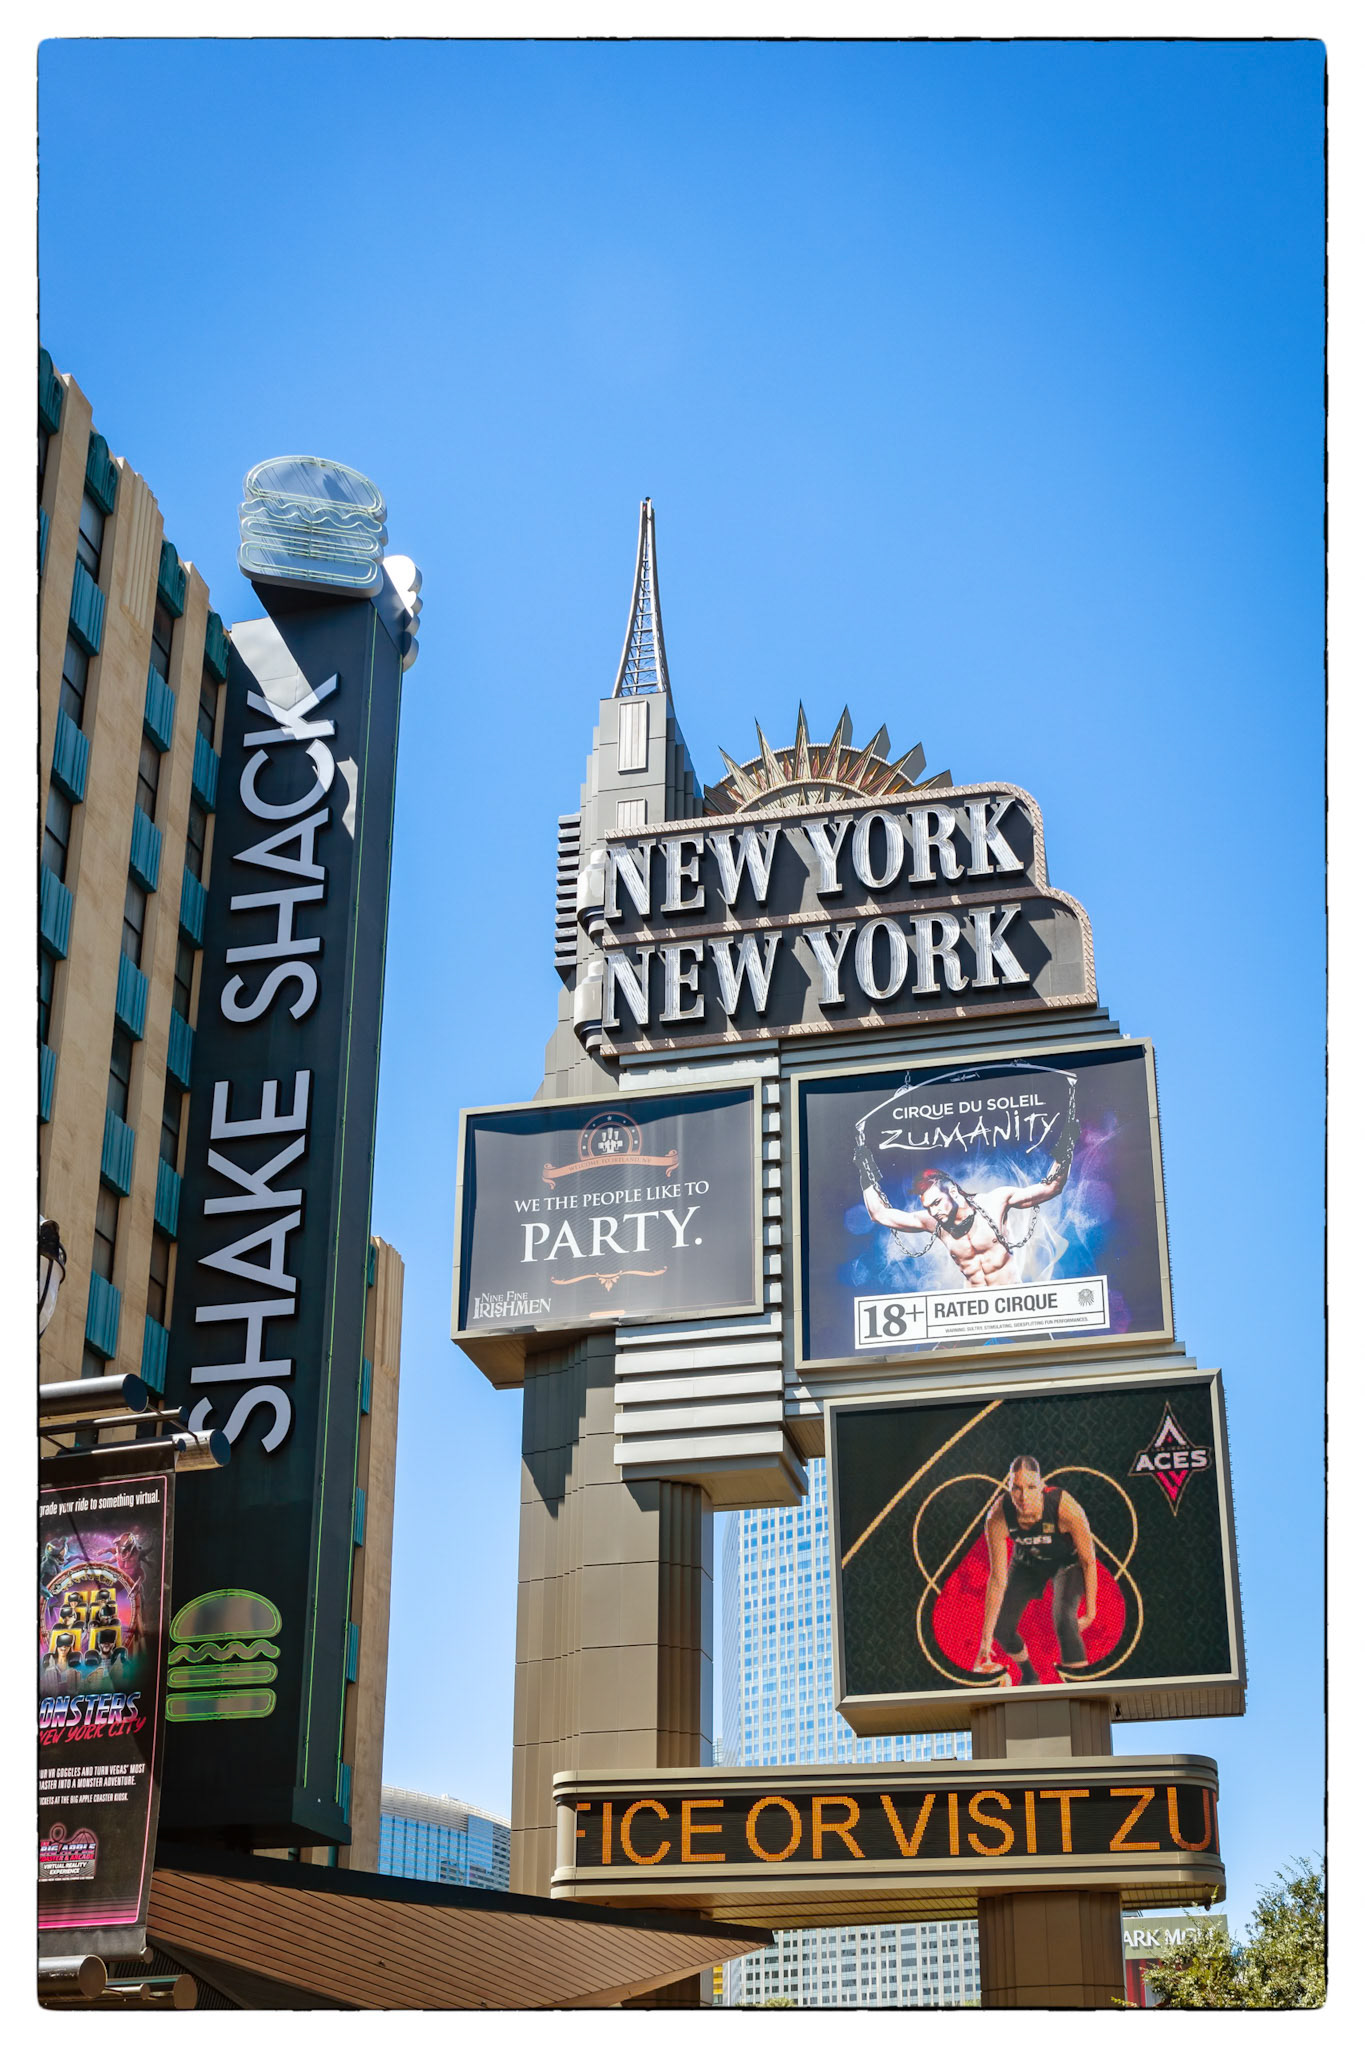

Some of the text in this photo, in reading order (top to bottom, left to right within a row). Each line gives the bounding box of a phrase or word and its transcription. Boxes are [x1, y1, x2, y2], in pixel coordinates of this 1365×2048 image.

[604, 795, 1026, 920] NEW YORK
[602, 903, 1031, 1031] NEW YORK
[188, 672, 340, 1453] SHAKE SHACK
[892, 1094, 1046, 1120] CIRQUE DU SOLEIL
[879, 1110, 1060, 1154] ZUMANITY
[602, 1158, 610, 1166] TO
[514, 1180, 710, 1213] WE THE PEOPLE LIKE TO
[520, 1205, 703, 1263] PARTY.
[472, 1297, 552, 1319] IRISHMEN
[934, 1292, 1058, 1319] RATED CIRQUE
[863, 1302, 925, 1339] 18+
[1136, 1450, 1208, 1472] ACES
[59, 1500, 74, 1516] your
[75, 1497, 88, 1512] ride
[90, 1497, 98, 1511] to
[98, 1492, 134, 1509] something
[135, 1489, 160, 1505] virtual.
[1015, 1535, 1053, 1546] ACES
[65, 1722, 105, 1743] YORK
[108, 1716, 147, 1738] CITY
[48, 1768, 56, 1779] VR
[56, 1767, 81, 1778] GOGGLES
[81, 1766, 93, 1777] AND
[94, 1765, 108, 1776] TURN
[129, 1763, 146, 1774] MOST
[58, 1778, 71, 1789] INTO
[72, 1778, 76, 1789] A
[77, 1777, 103, 1788] MONSTER
[103, 1775, 136, 1787] ADVENTURE.
[61, 1795, 69, 1804] THE
[70, 1795, 79, 1804] BIG
[79, 1794, 93, 1803] APPLE
[93, 1793, 113, 1803] COASTER
[746, 1795, 866, 1862] OR
[880, 1789, 1090, 1857] VISIT
